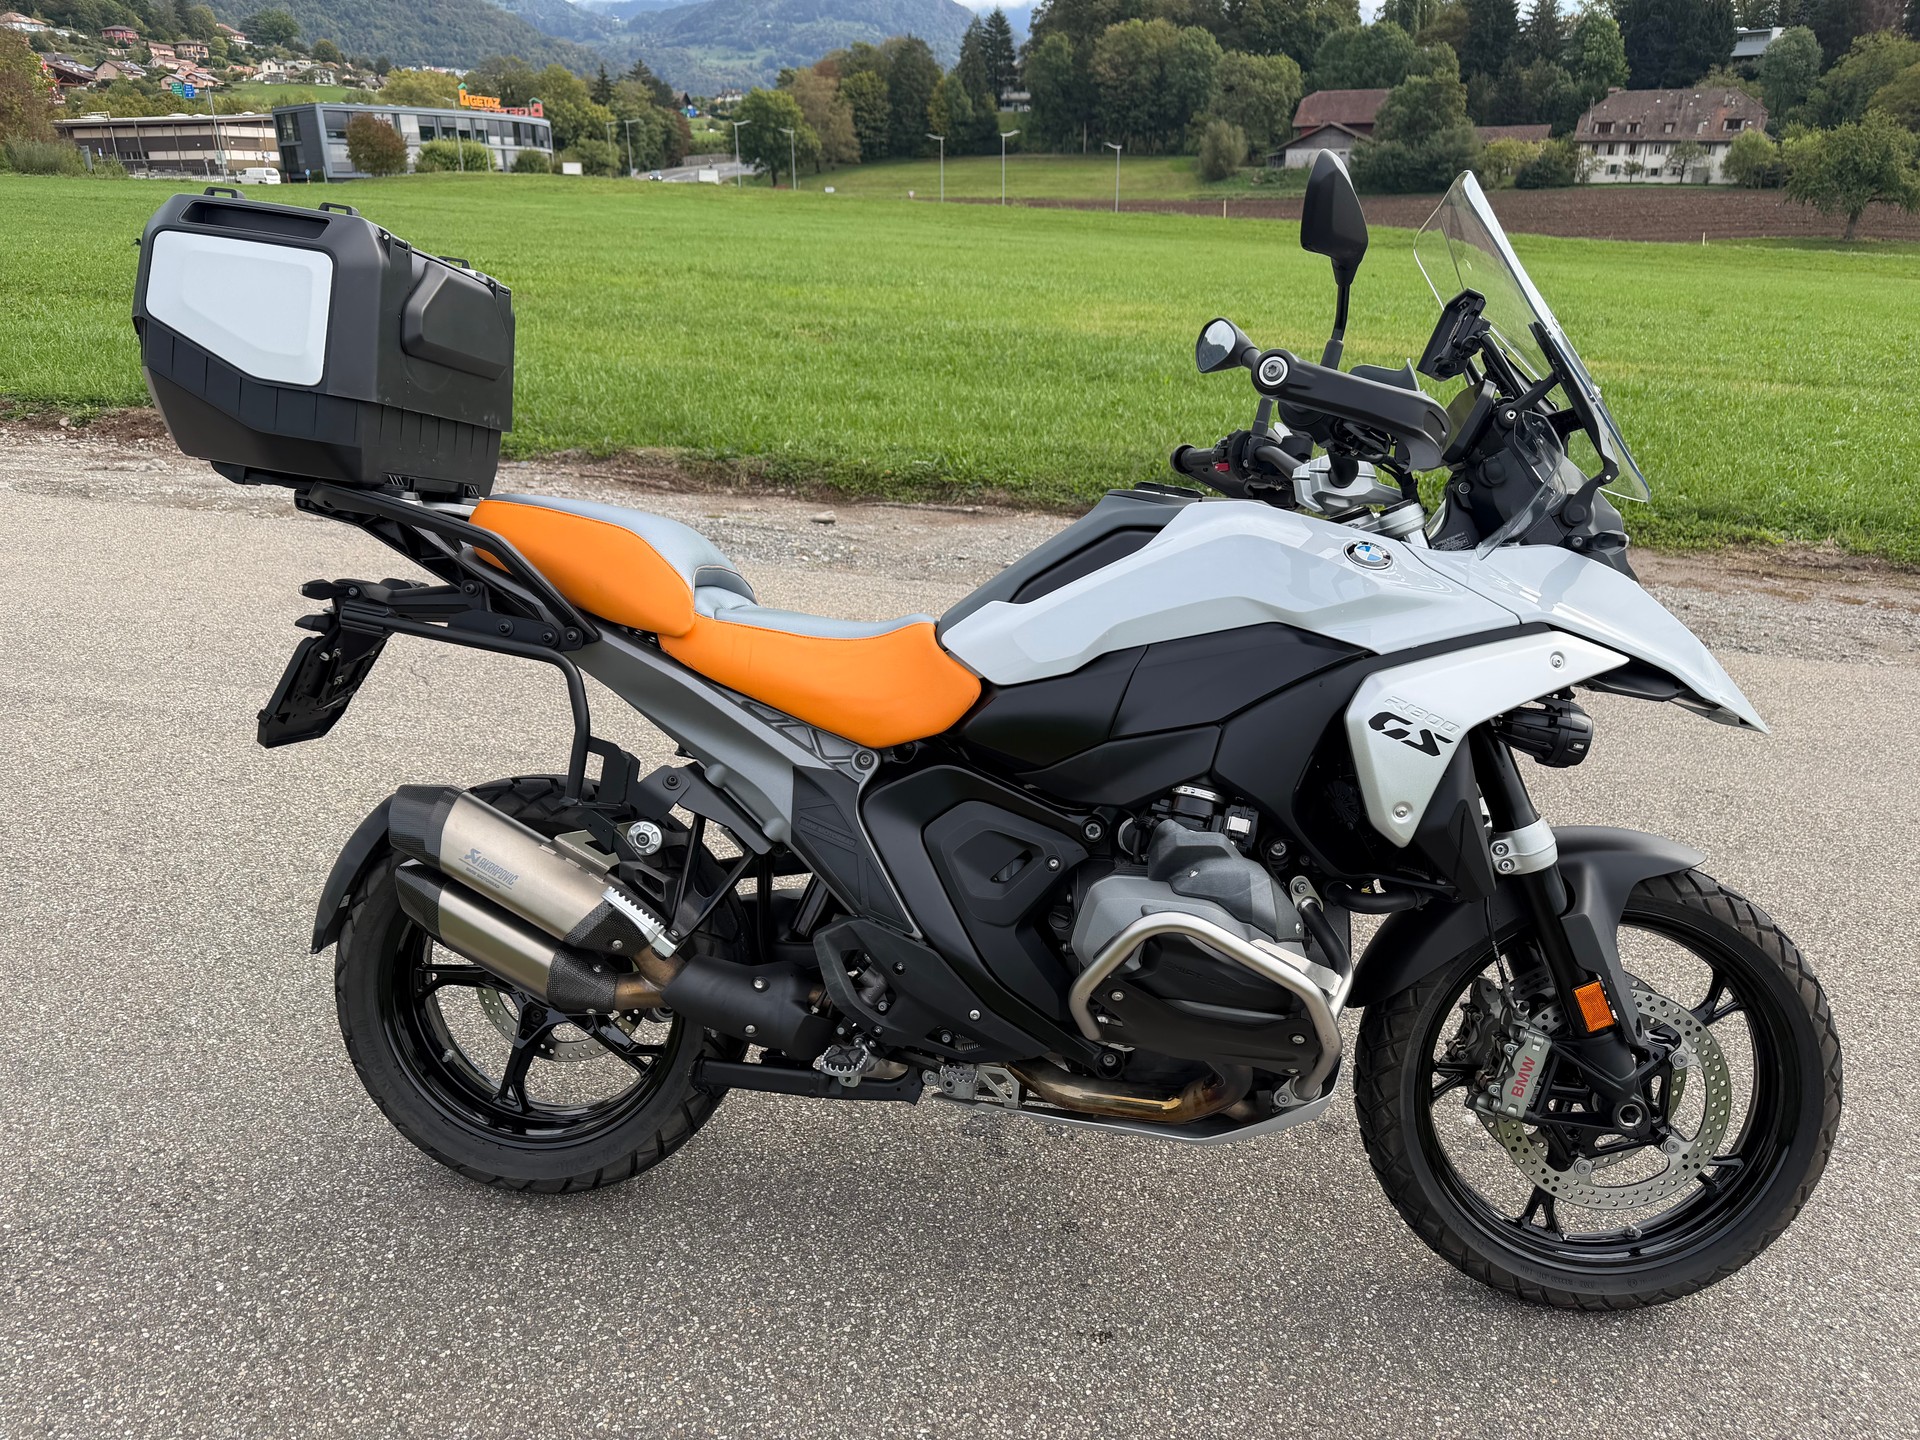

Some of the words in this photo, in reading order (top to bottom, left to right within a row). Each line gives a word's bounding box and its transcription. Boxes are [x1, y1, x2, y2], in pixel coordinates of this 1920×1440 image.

[469, 95, 501, 109] GETAZ
[1368, 711, 1454, 757] GS
[1511, 1055, 1536, 1098] BMW
